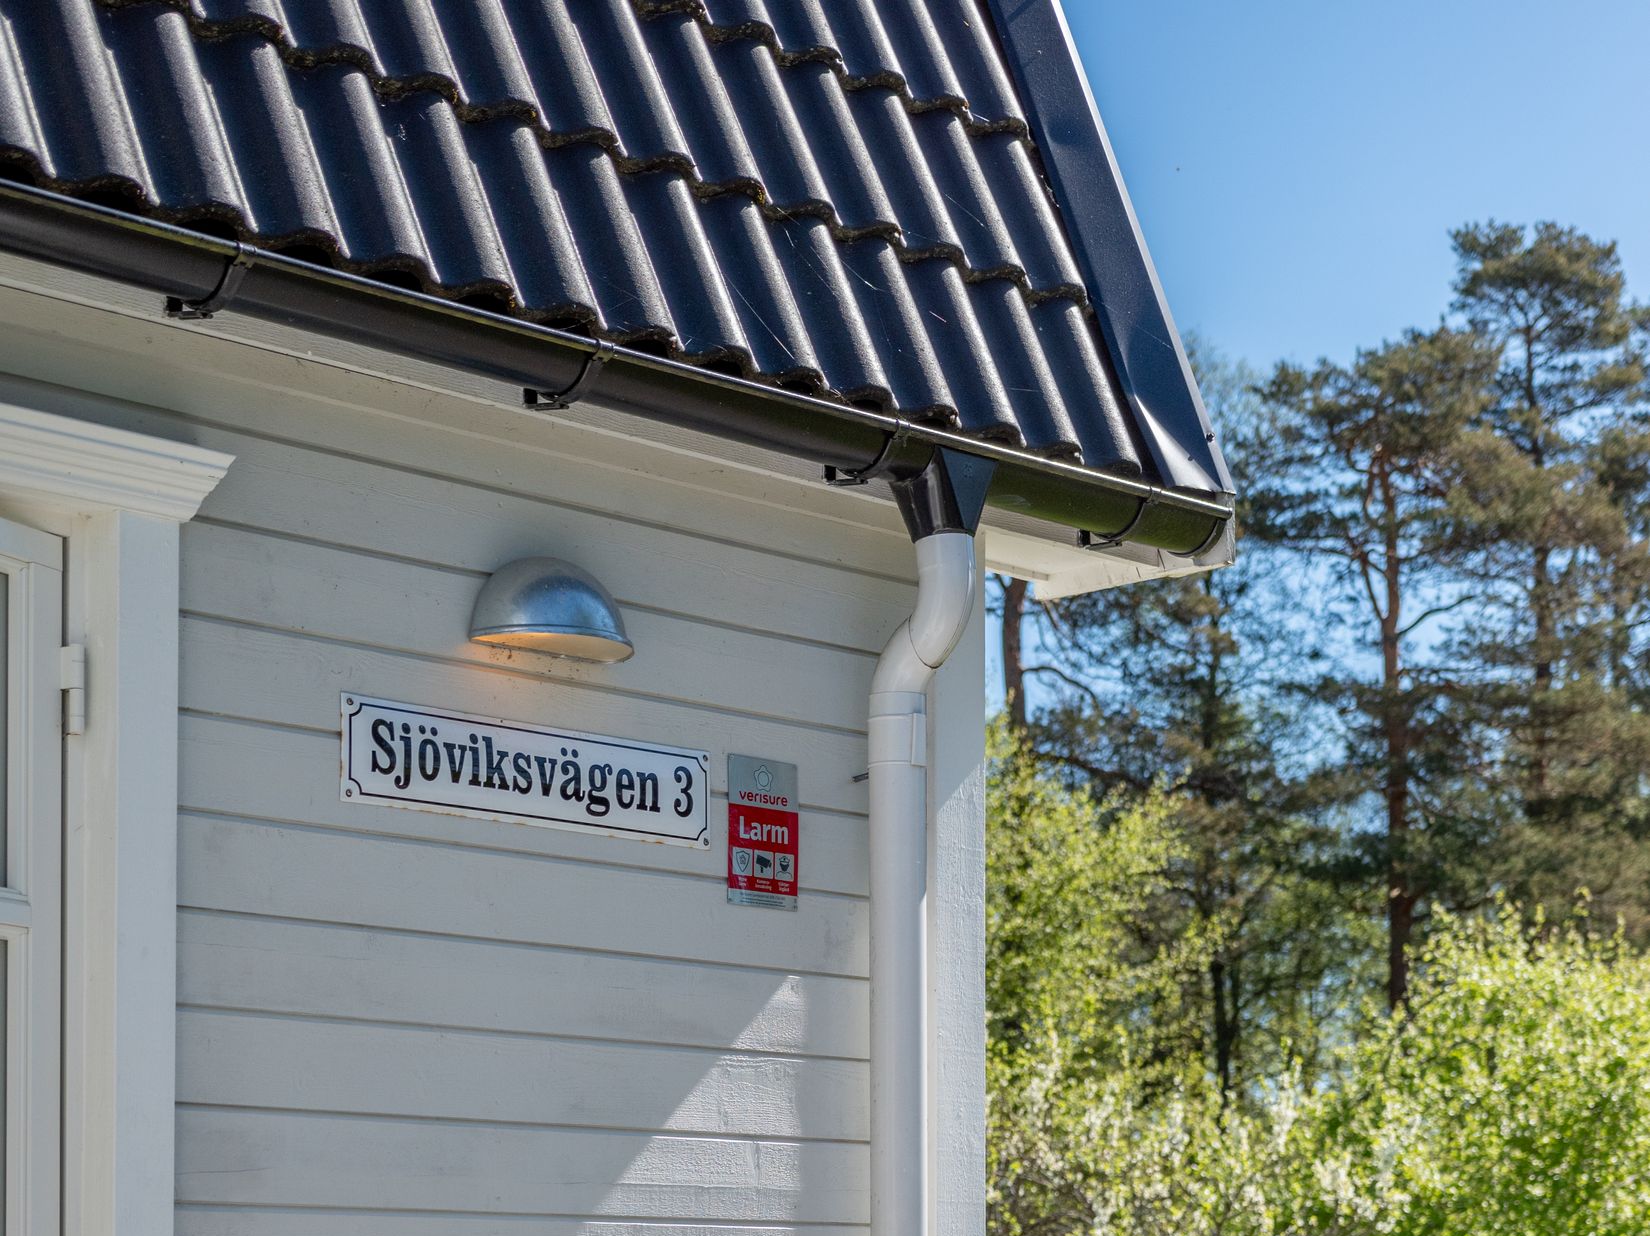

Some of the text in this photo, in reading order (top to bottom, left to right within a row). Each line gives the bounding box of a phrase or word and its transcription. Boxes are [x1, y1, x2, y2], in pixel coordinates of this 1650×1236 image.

[371, 718, 694, 818] Sjöviksvägen 3
[739, 790, 788, 807] verisure
[739, 815, 789, 845] Larm
